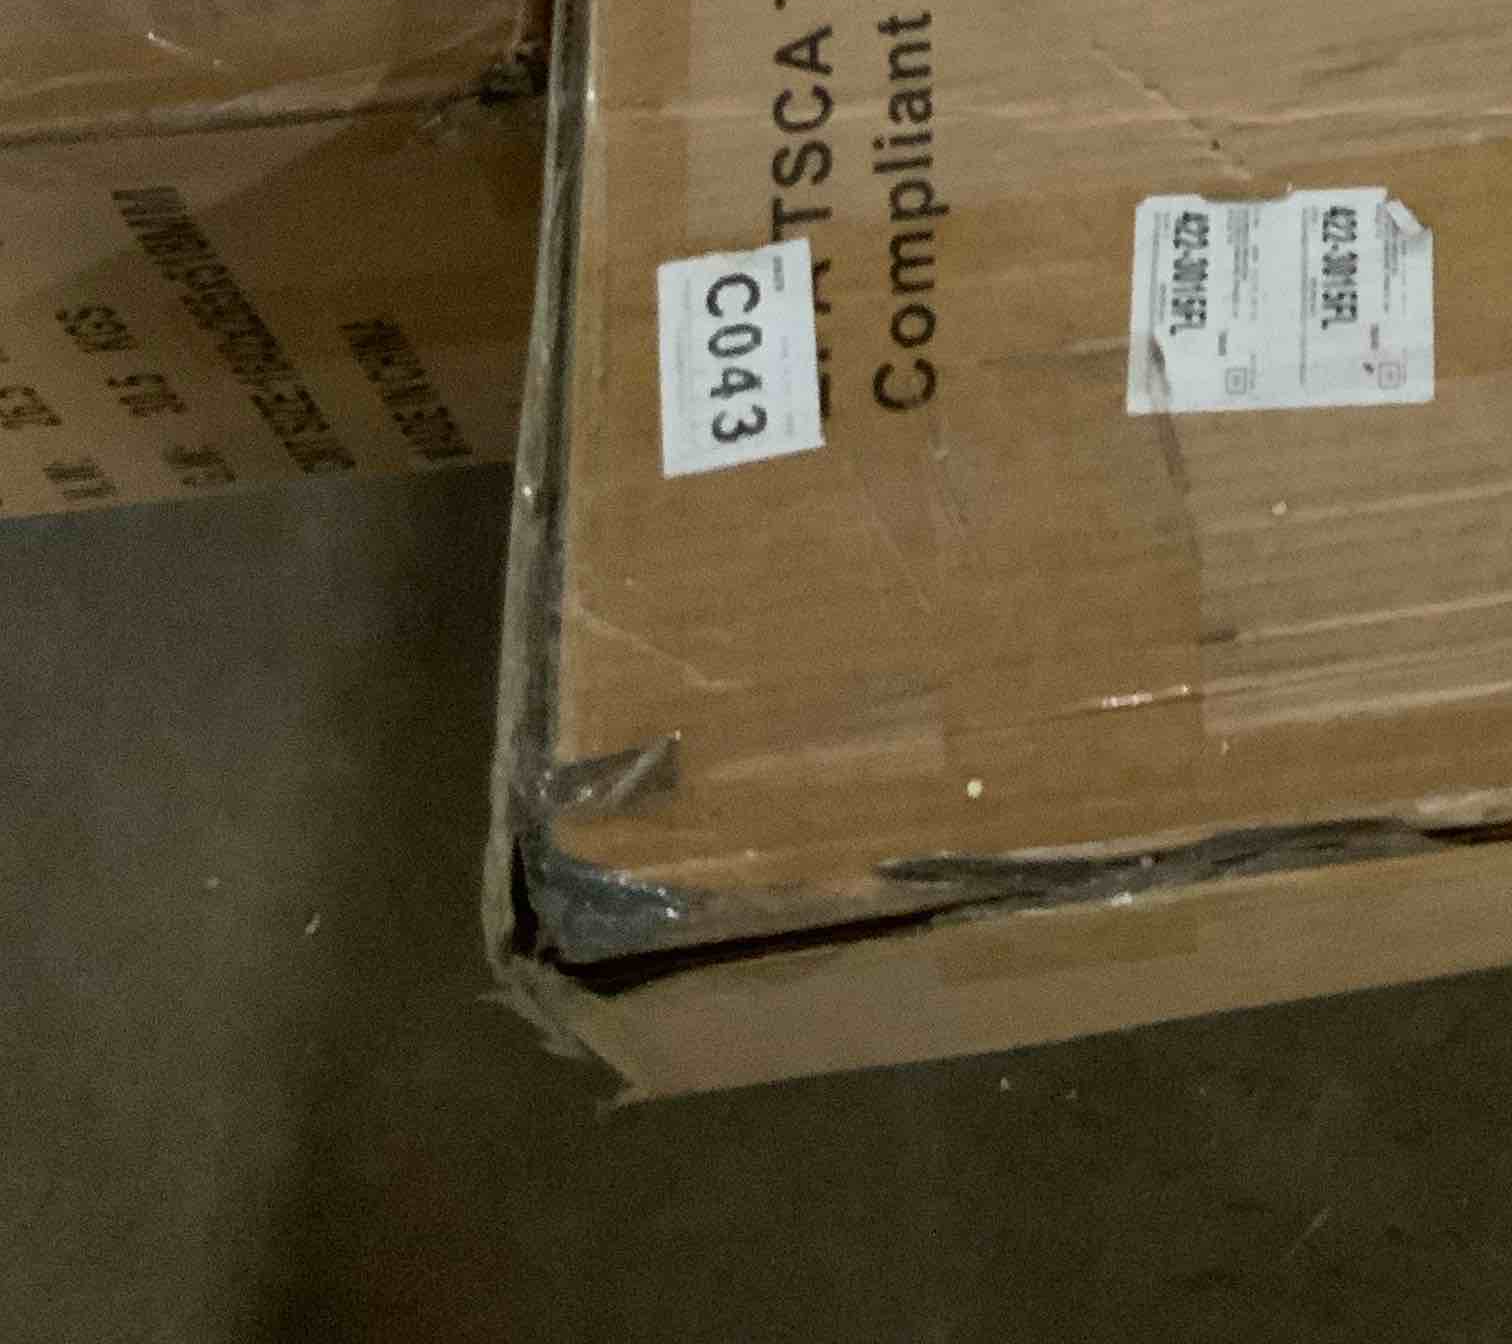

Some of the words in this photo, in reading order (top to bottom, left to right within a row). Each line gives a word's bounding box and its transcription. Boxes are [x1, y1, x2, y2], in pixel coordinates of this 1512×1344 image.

[769, 26, 833, 242] TSCA
[873, 12, 950, 413] Compliant
[706, 272, 768, 445] C043
